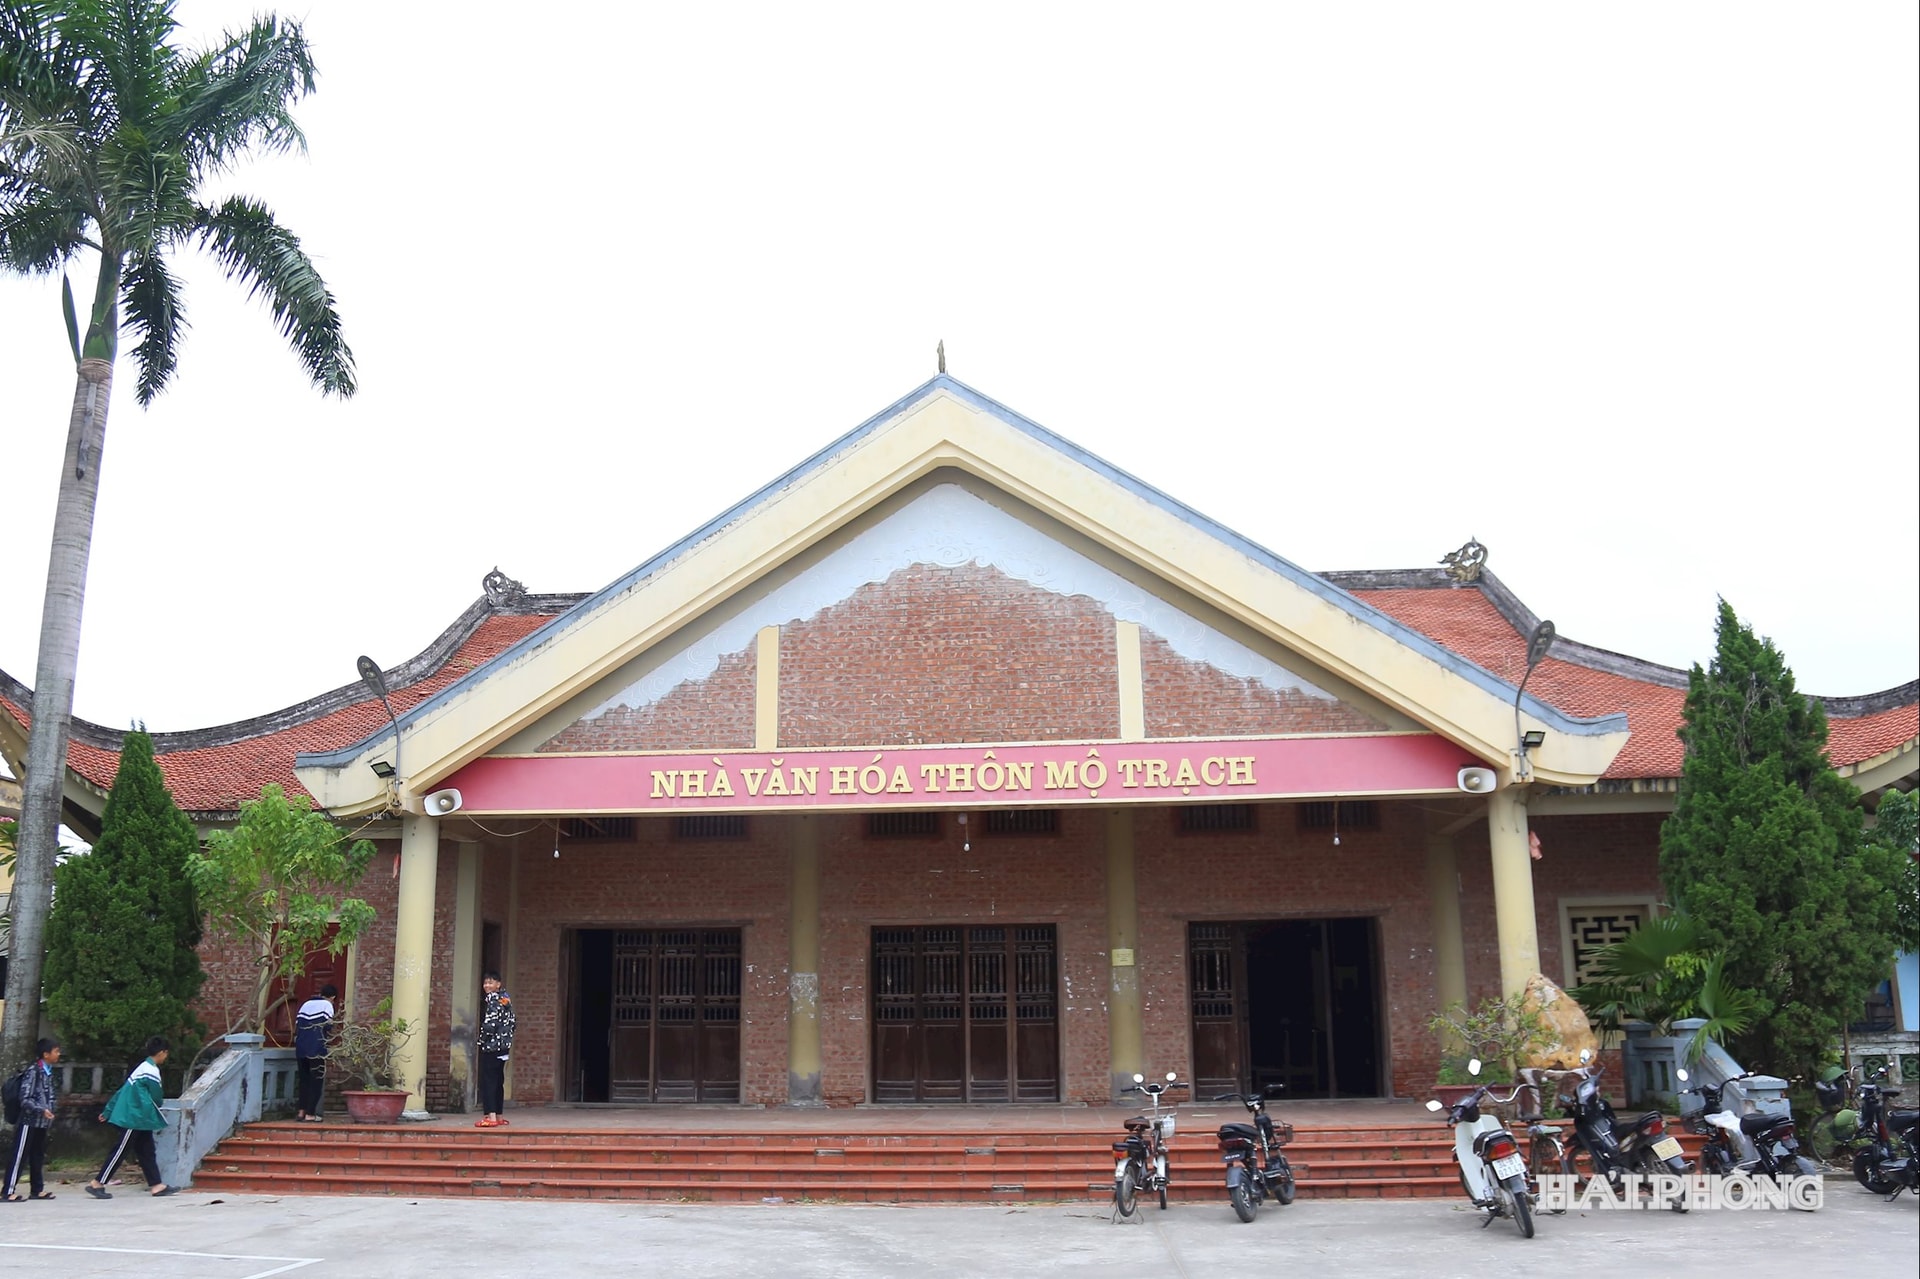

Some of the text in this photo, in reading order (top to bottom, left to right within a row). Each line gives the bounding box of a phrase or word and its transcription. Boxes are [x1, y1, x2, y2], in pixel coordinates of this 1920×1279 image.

[650, 748, 1257, 798] NHÀ VĂN HÓA THÔN MỘ TRẠCH
